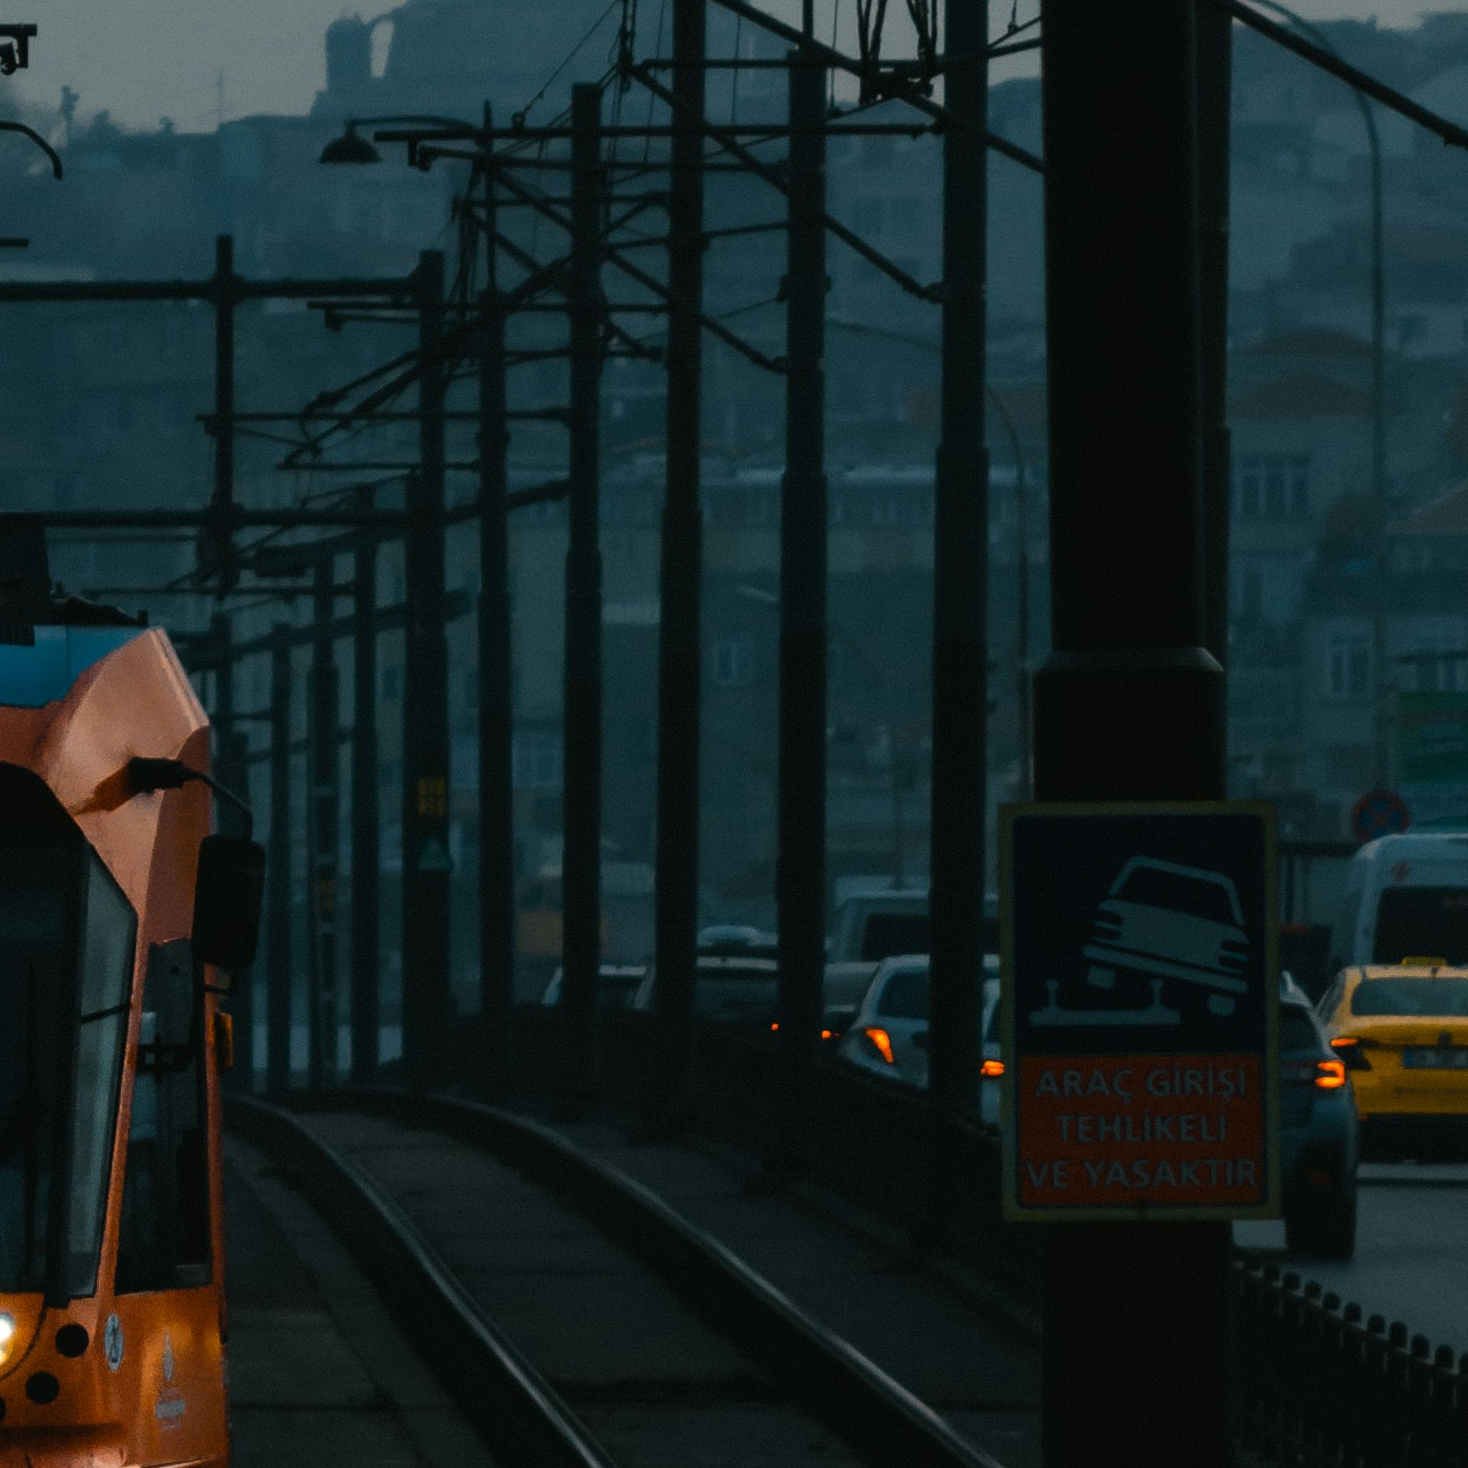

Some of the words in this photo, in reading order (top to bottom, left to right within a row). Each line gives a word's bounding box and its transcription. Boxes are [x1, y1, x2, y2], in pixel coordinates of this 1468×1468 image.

[1034, 1068, 1134, 1105] ARAÇ
[1145, 1061, 1247, 1102] GİRİŞİ
[1055, 1108, 1228, 1143] TEHLİKELİ
[1025, 1159, 1069, 1189] VE
[1081, 1158, 1258, 1189] YASAKTIR
